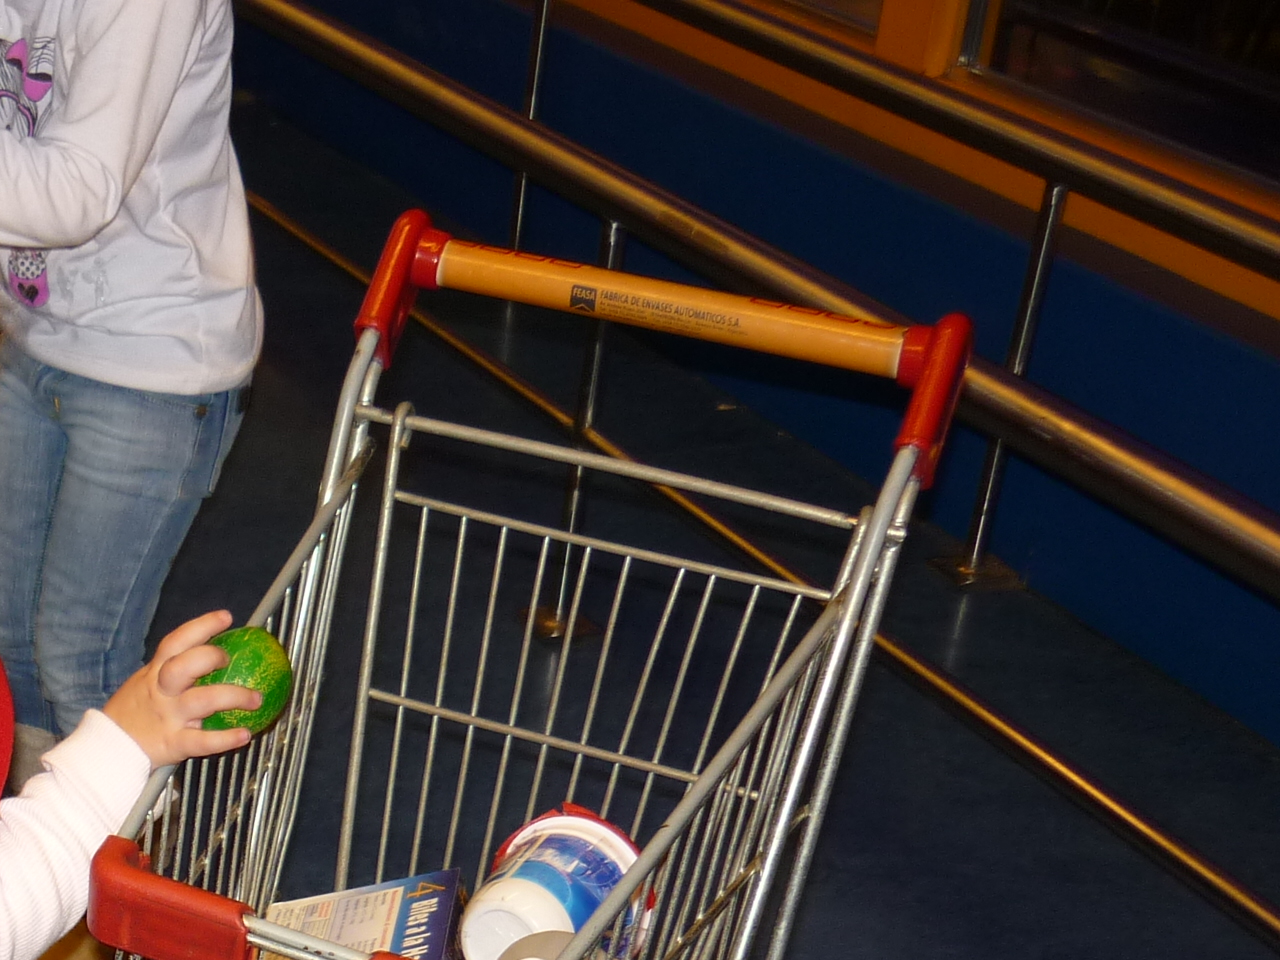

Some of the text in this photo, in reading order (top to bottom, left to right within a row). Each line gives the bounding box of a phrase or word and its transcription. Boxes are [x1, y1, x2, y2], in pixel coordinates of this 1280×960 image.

[572, 287, 595, 301] FEASA
[600, 289, 630, 305] FABRICA
[631, 297, 641, 307] DE
[641, 299, 673, 314] ENVASES
[674, 304, 726, 325] AUTOMATICOS
[406, 882, 446, 899] 4
